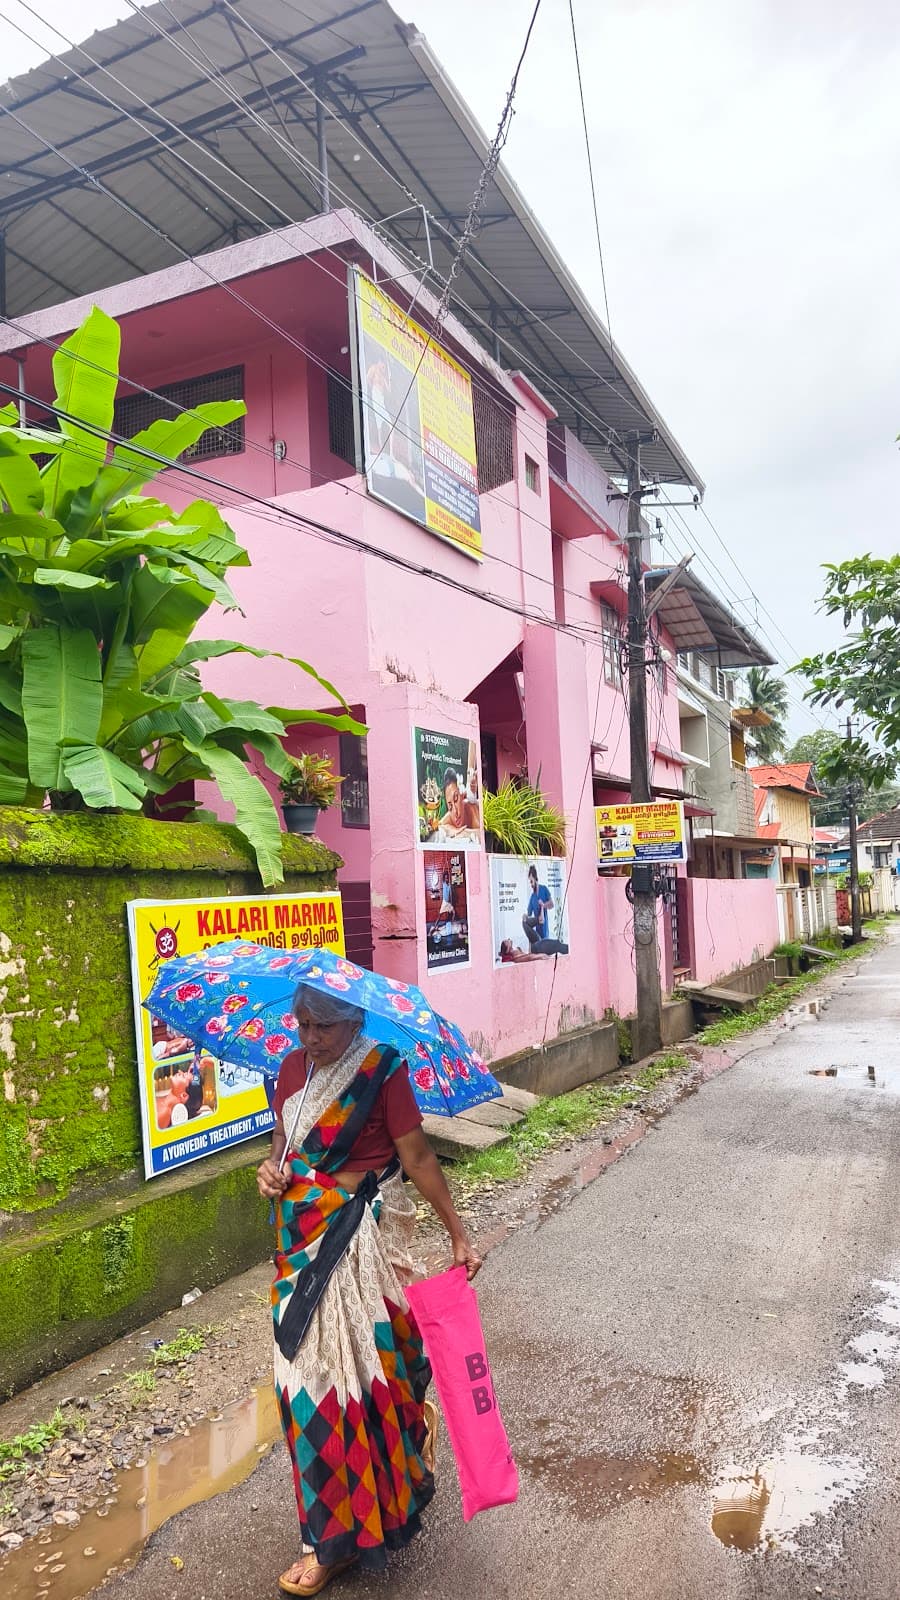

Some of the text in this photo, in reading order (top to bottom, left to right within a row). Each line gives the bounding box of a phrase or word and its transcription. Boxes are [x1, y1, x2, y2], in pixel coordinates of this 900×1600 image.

[421, 751, 442, 761] Ayurvedic
[615, 803, 677, 815] KALARI MARMA
[196, 902, 338, 937] KALARI MARMA
[428, 951, 441, 961] Kalari
[455, 948, 467, 957] Clinic
[162, 1110, 273, 1163] AYURVEDIC TREATMENT, YOGA
[465, 1352, 489, 1382] B
[472, 1386, 496, 1415] B
